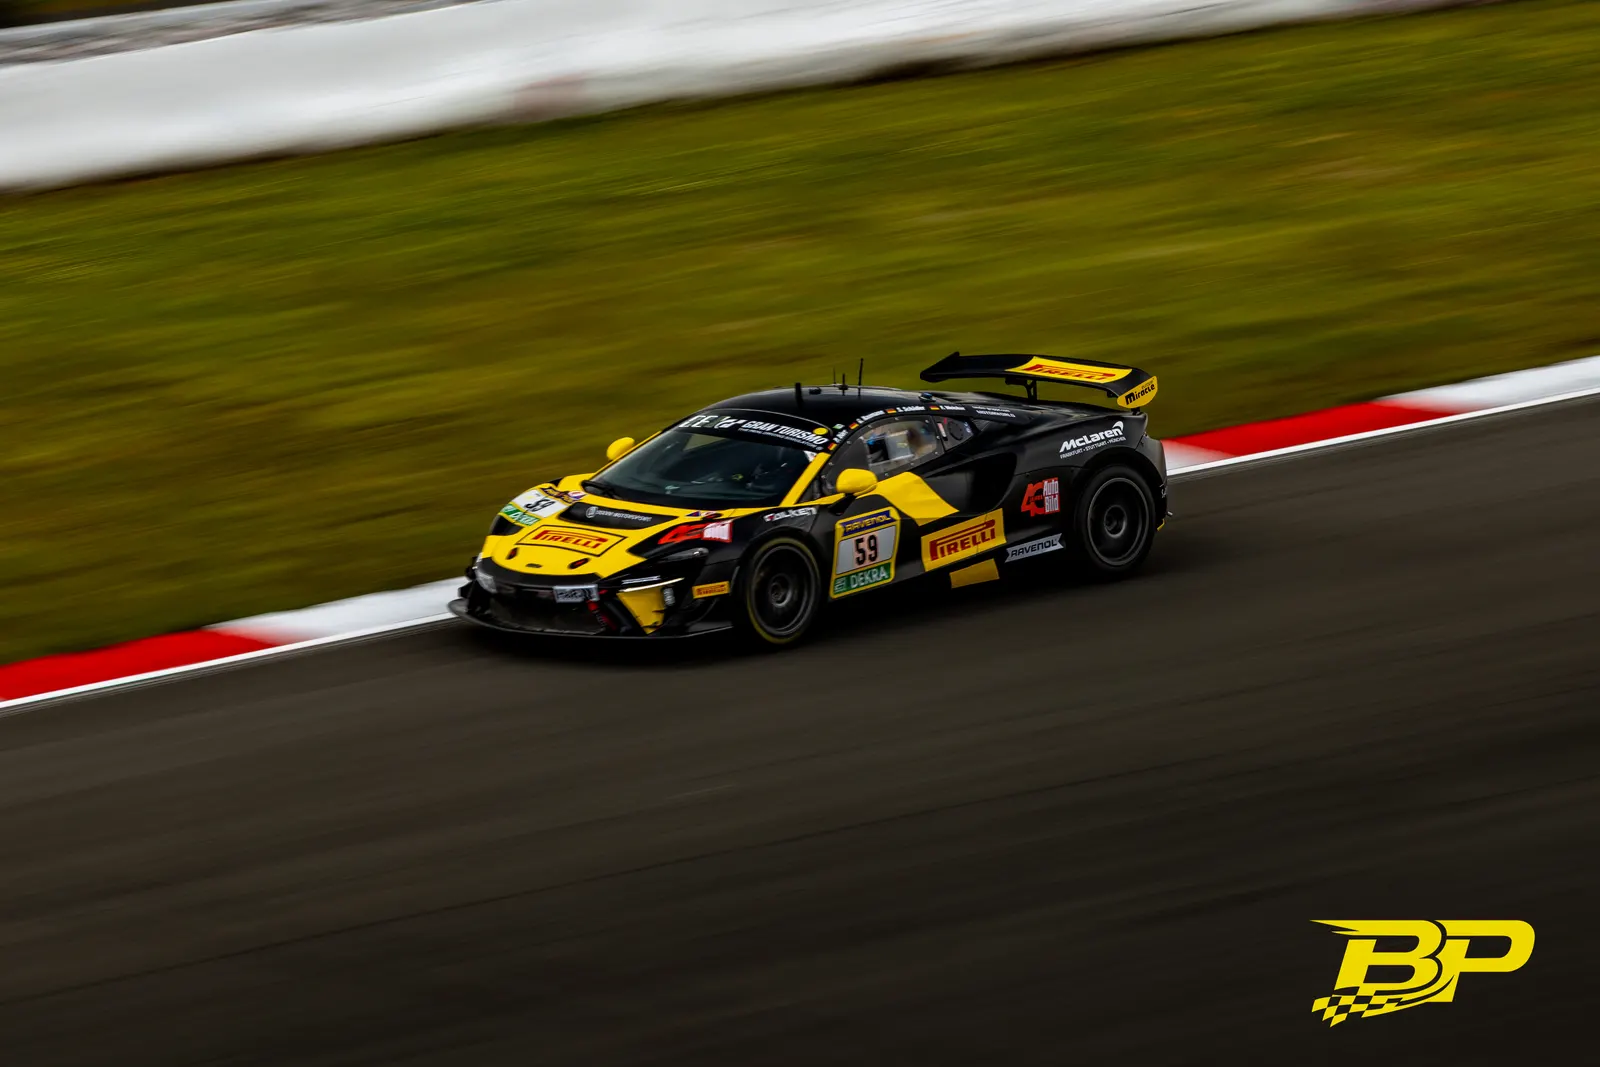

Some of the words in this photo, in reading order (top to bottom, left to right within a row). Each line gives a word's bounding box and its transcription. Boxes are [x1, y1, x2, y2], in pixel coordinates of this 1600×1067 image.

[1024, 364, 1116, 381] PIRELLI
[1125, 383, 1155, 405] Miracle
[741, 420, 776, 432] GRAN
[775, 424, 829, 445] TURISMO
[1059, 426, 1124, 453] McLaren
[1085, 441, 1107, 451] STUTTGART
[1043, 479, 1059, 496] Auto
[1045, 494, 1059, 513] Bild
[845, 514, 891, 533] RAVENOL
[532, 530, 608, 549] PIRELLI
[929, 519, 996, 561] PIRELLI
[1010, 538, 1058, 557] RAVENOL
[854, 534, 878, 565] 59
[851, 567, 889, 589] DEKRA
